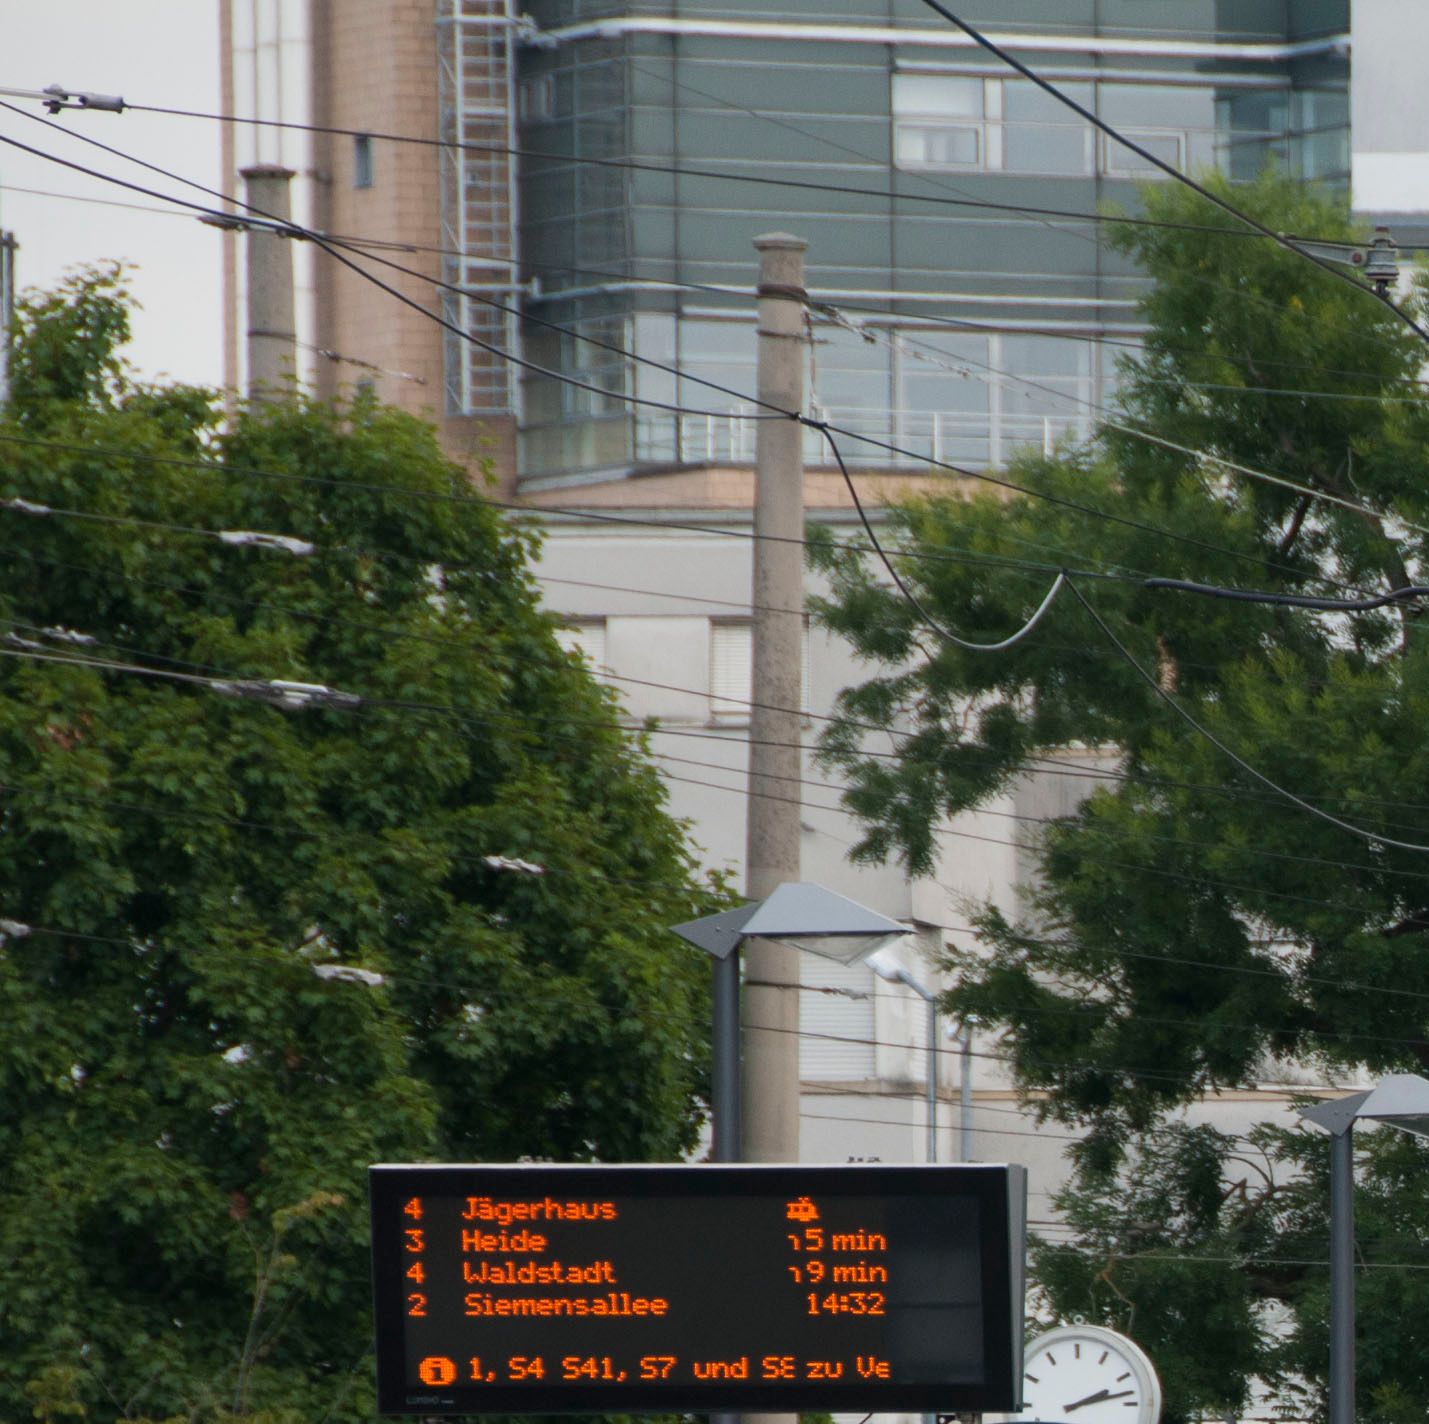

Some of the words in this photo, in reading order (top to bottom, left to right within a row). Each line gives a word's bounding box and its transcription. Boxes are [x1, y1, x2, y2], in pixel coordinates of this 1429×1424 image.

[404, 1197, 423, 1220] 4
[462, 1197, 618, 1226] Jägerhaus
[405, 1229, 424, 1252] 3
[462, 1229, 547, 1252] Heide
[832, 1228, 887, 1251] min
[406, 1261, 425, 1284] 4
[463, 1261, 618, 1284] Waldstadt
[833, 1260, 888, 1283] min
[407, 1293, 427, 1316] 2
[465, 1292, 668, 1316] Siemensallee
[807, 1292, 885, 1315] 14:32
[508, 1356, 545, 1380] S4
[562, 1356, 628, 1383] S41,
[640, 1356, 678, 1380] S7
[693, 1356, 749, 1380] und
[806, 1360, 843, 1380] zu
